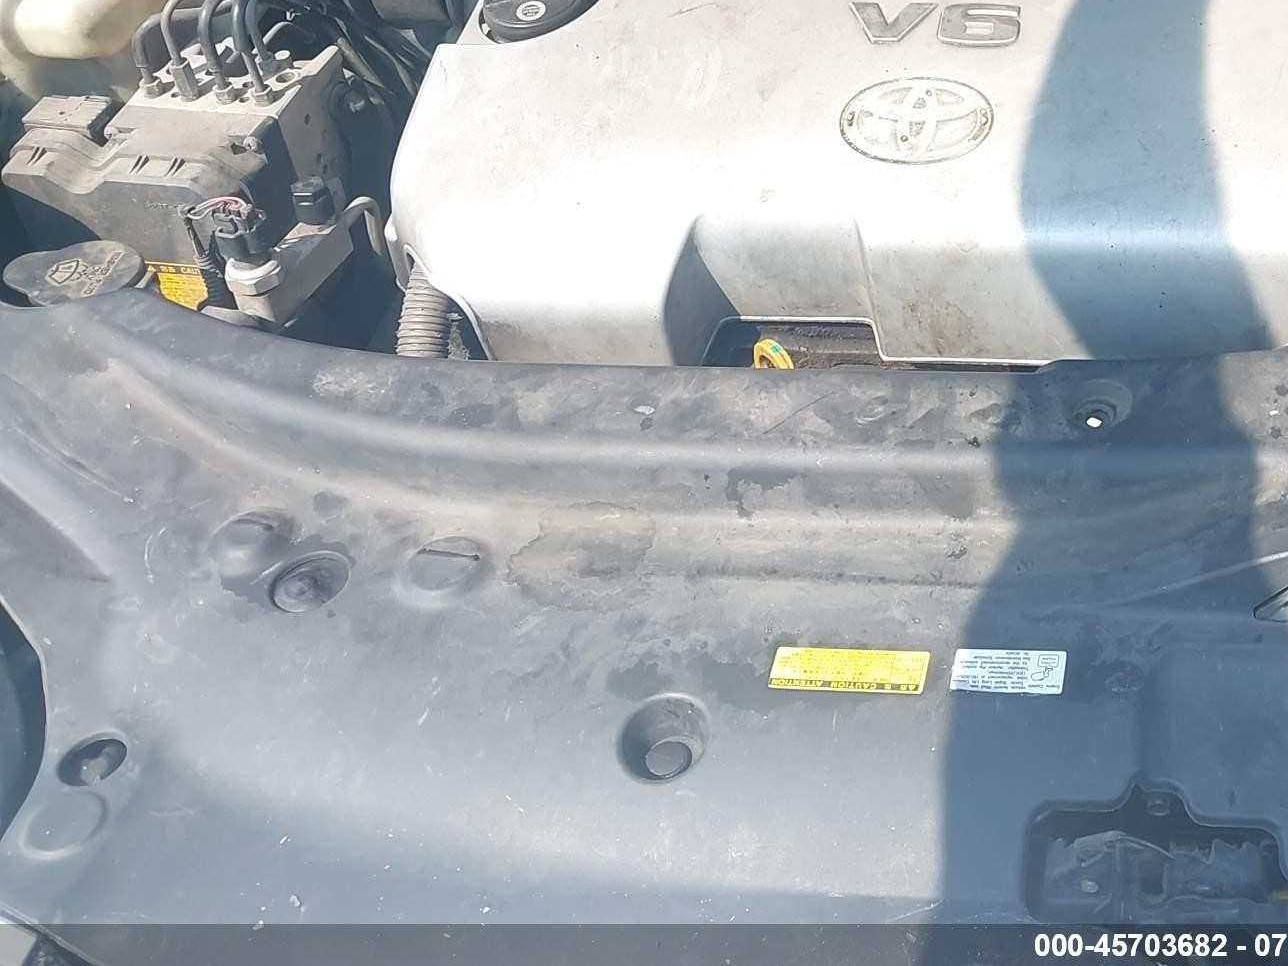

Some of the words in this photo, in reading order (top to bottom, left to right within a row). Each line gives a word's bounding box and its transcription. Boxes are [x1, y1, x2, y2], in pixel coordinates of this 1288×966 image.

[849, 1, 1023, 47] V6
[770, 677, 824, 687] ATTENTION
[830, 681, 877, 690] CAUTION
